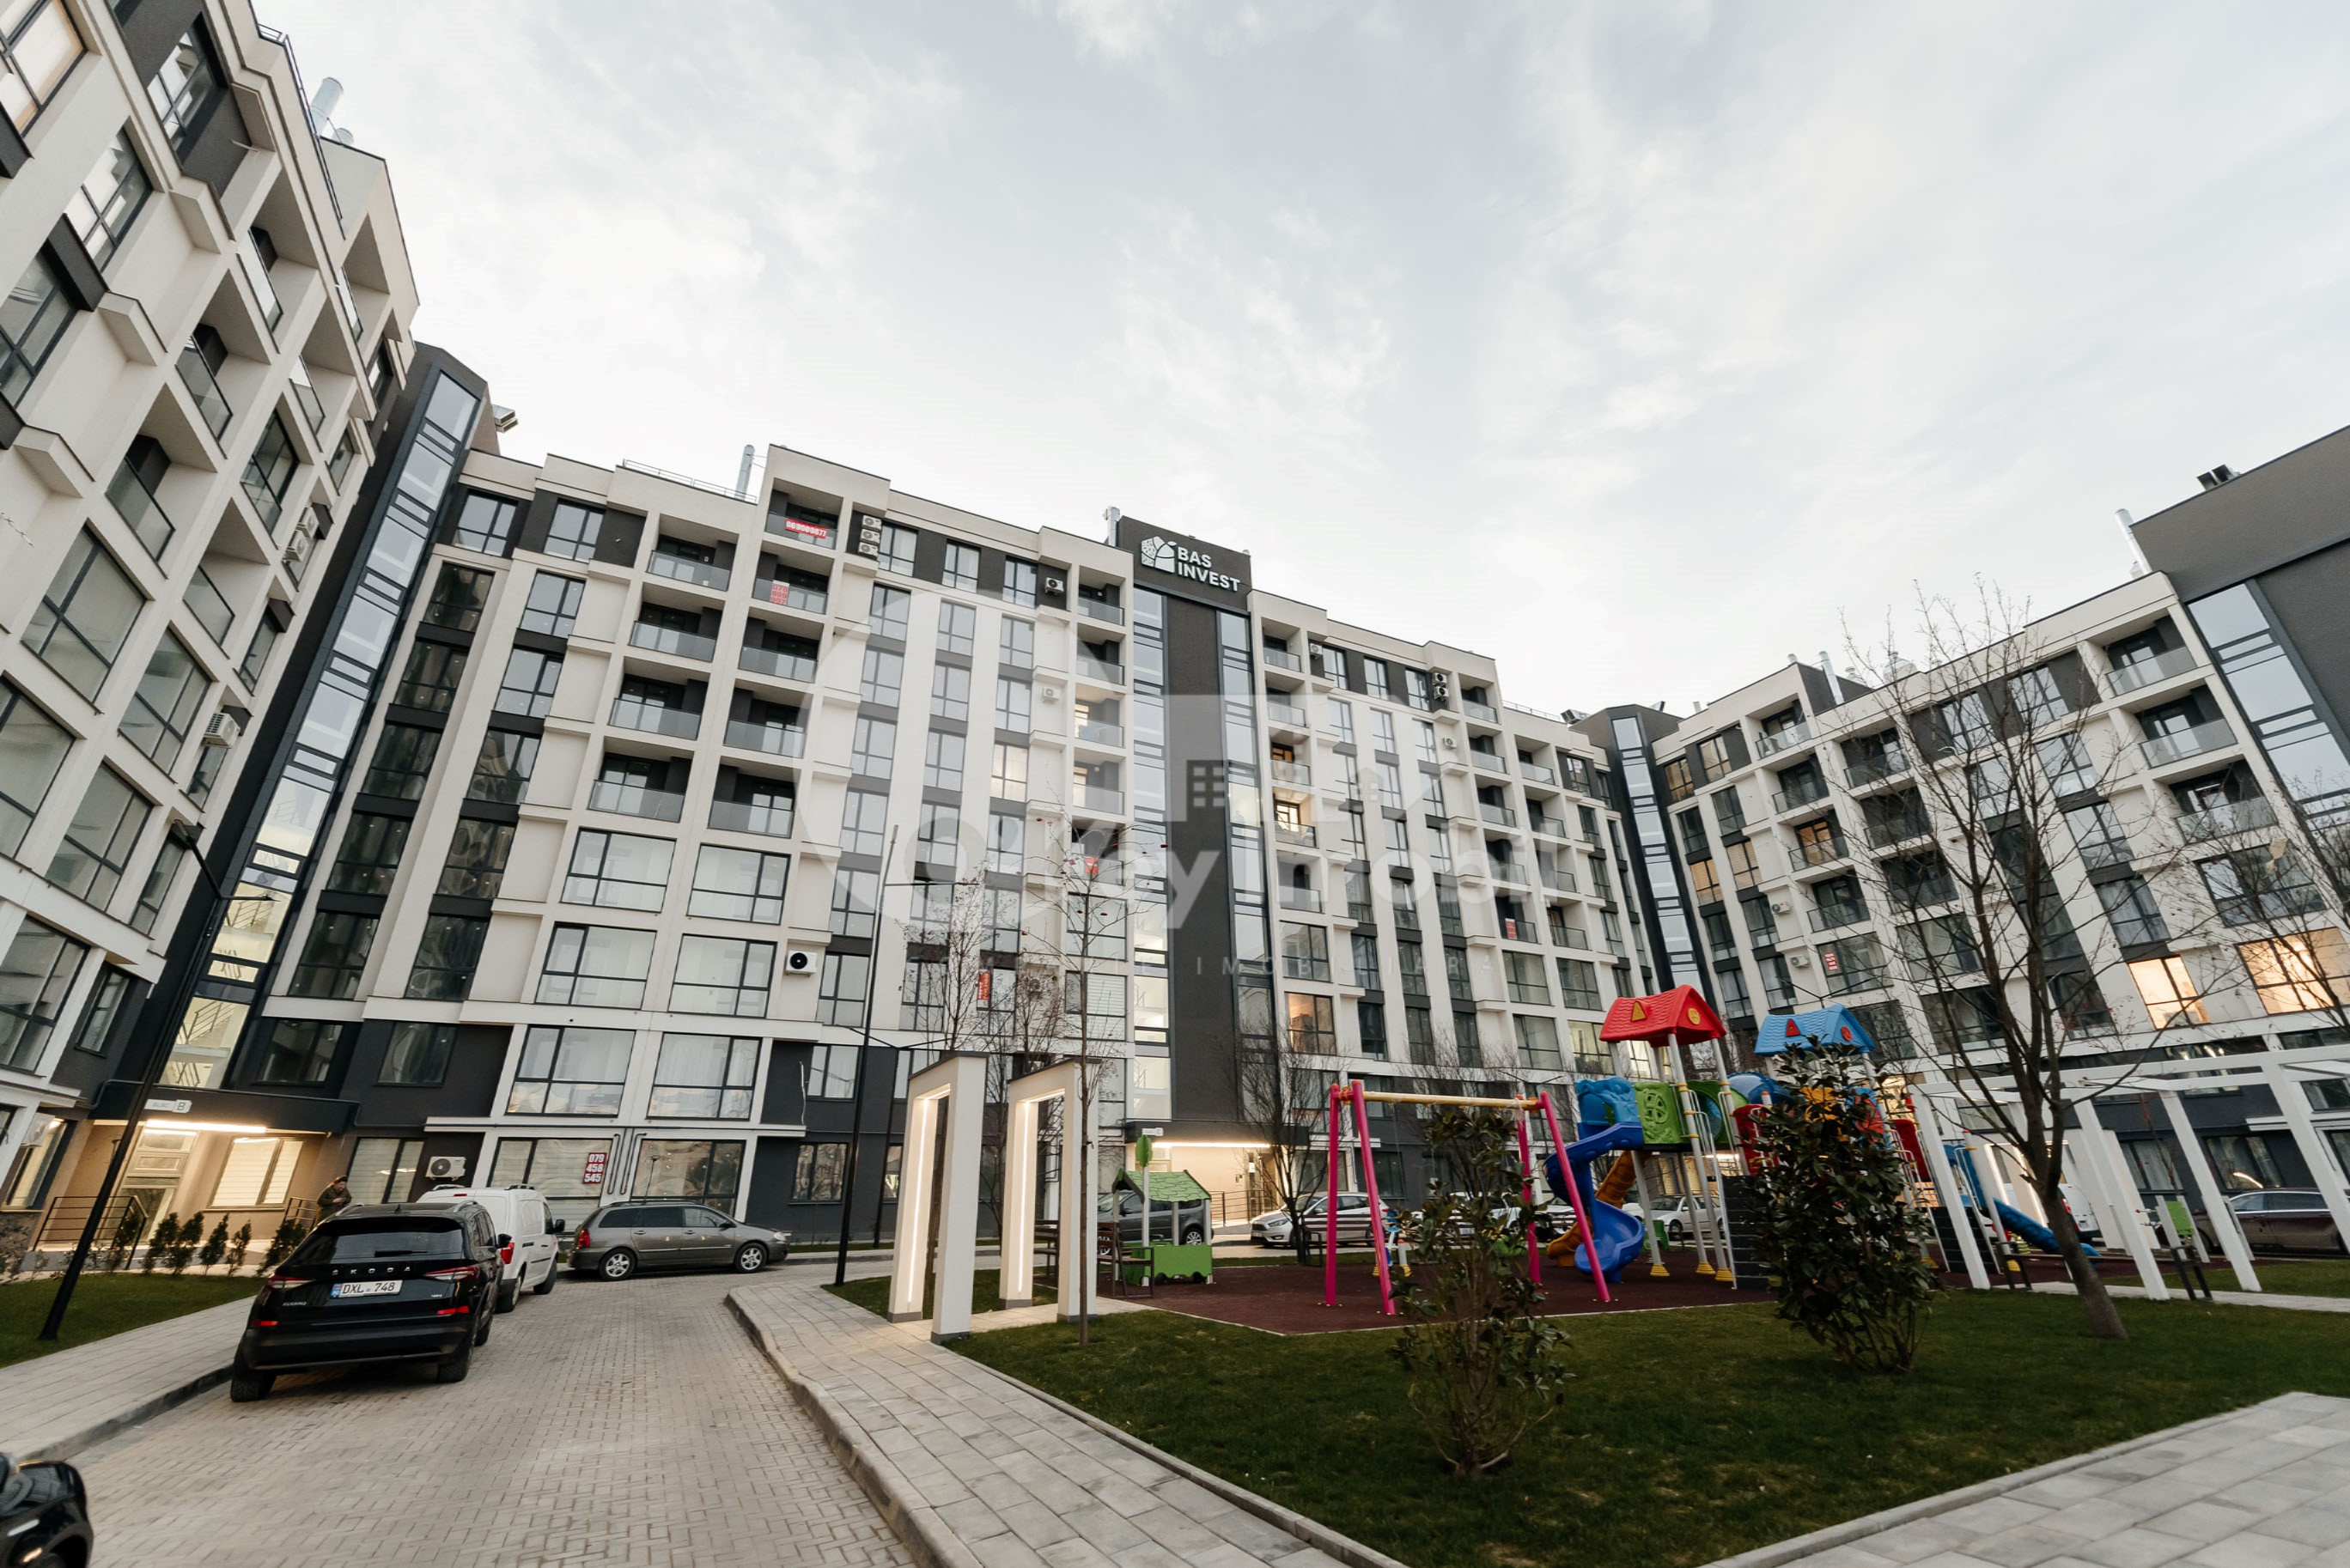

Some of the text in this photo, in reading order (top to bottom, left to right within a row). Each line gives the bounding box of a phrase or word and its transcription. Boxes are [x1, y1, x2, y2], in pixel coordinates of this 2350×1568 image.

[1178, 547, 1212, 568] BAS
[1178, 562, 1240, 592] INVEST
[177, 1102, 186, 1111] B
[588, 1153, 605, 1163] 079
[586, 1164, 604, 1172] 458
[584, 1173, 601, 1182] 545
[342, 1282, 396, 1294] DXL 748
